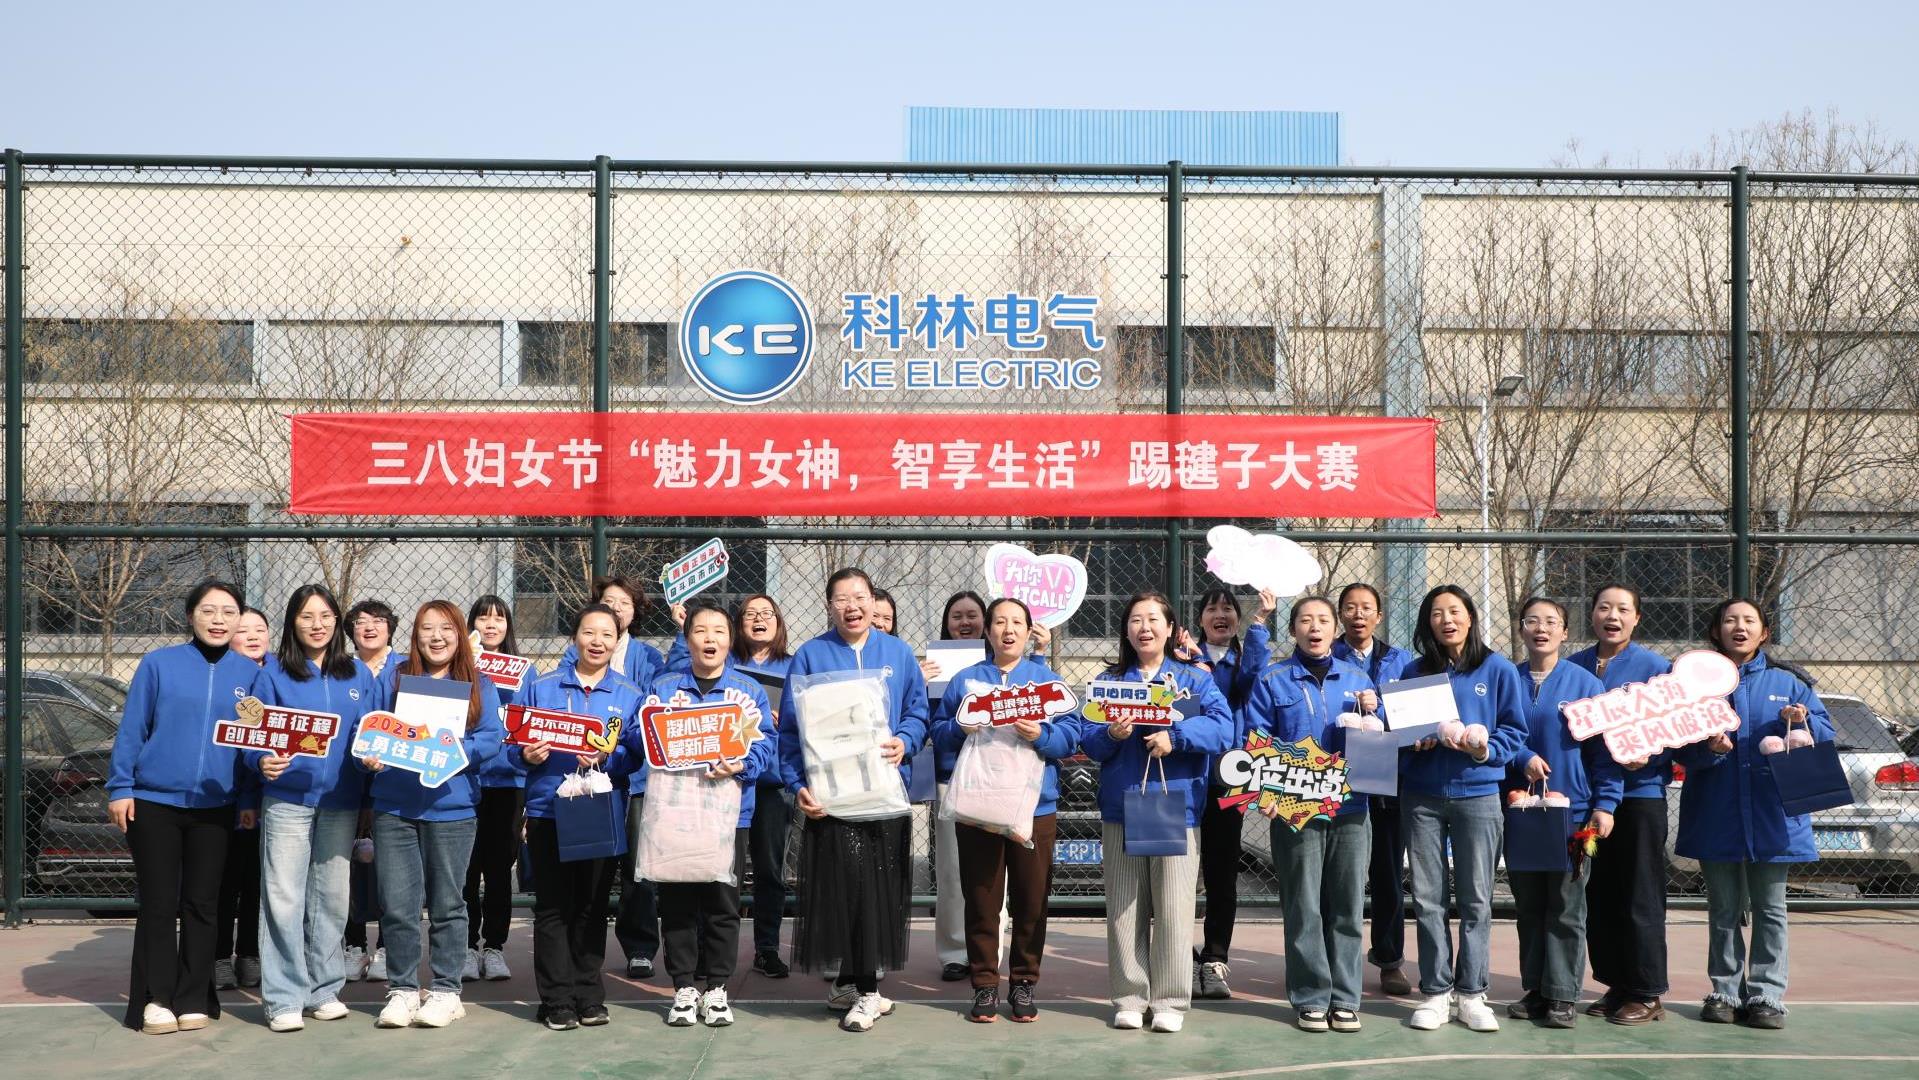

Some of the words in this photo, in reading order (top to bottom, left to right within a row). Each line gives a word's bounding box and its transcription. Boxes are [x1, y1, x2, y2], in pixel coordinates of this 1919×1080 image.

[843, 294, 1104, 350] 科林电气
[699, 324, 798, 356] KE
[844, 361, 897, 388] KE
[907, 360, 1101, 389] ELECTRIC
[367, 438, 602, 489] 三八妇女节
[1127, 440, 1359, 491] 踢毽子大赛
[1093, 687, 1147, 700] 同心同行
[267, 711, 333, 734] 新征程
[368, 716, 417, 739] 2025
[530, 716, 586, 735] 势不可挡
[666, 712, 738, 739] 凝心聚力
[224, 726, 289, 749] 创辉煌
[667, 734, 721, 759] 攀新高
[1219, 749, 1346, 803] C位出道
